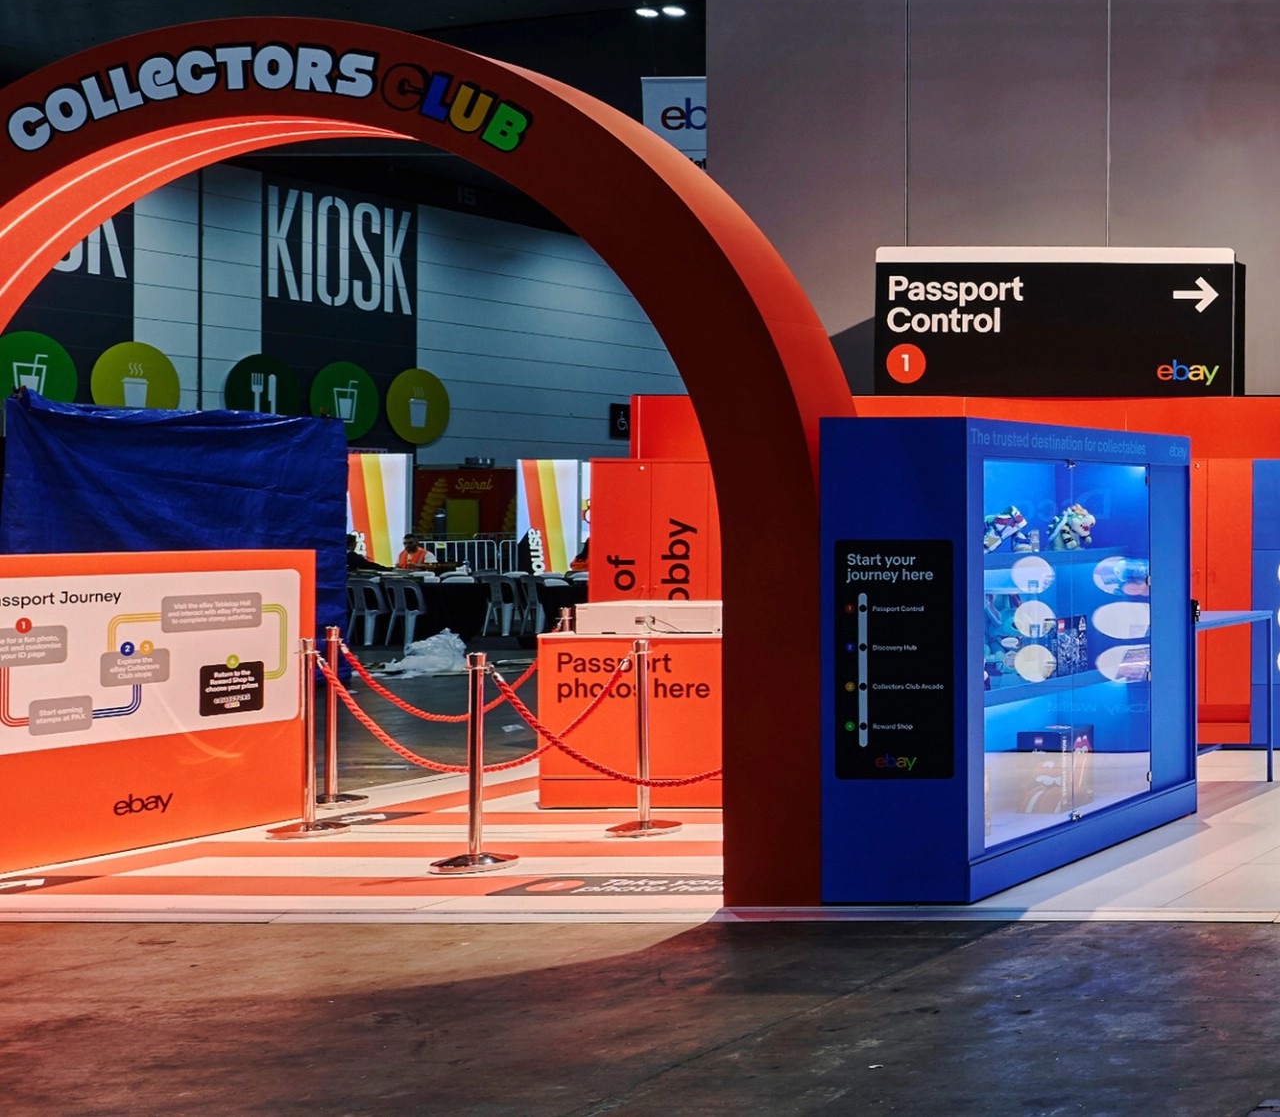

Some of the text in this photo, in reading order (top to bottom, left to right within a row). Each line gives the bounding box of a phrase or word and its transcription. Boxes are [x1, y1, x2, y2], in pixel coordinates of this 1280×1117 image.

[382, 61, 531, 151] CLUB
[268, 185, 412, 315] KIOSK
[888, 276, 1024, 307] Passport
[887, 307, 1001, 333] Control
[901, 354, 910, 372] 1
[1156, 359, 1219, 385] ebay
[970, 428, 1146, 456] The trusted destination for collectables
[1169, 442, 1188, 460] ebay
[455, 478, 493, 491] Spiral
[660, 518, 697, 601] obby
[847, 553, 916, 568] Start your
[606, 555, 636, 591] of
[846, 569, 934, 583] journey here
[59, 590, 122, 605] Journey
[872, 605, 900, 613] Passport
[654, 678, 710, 698] here
[897, 723, 914, 731] Shop
[875, 753, 917, 771] ebay
[113, 792, 174, 816] ebay
